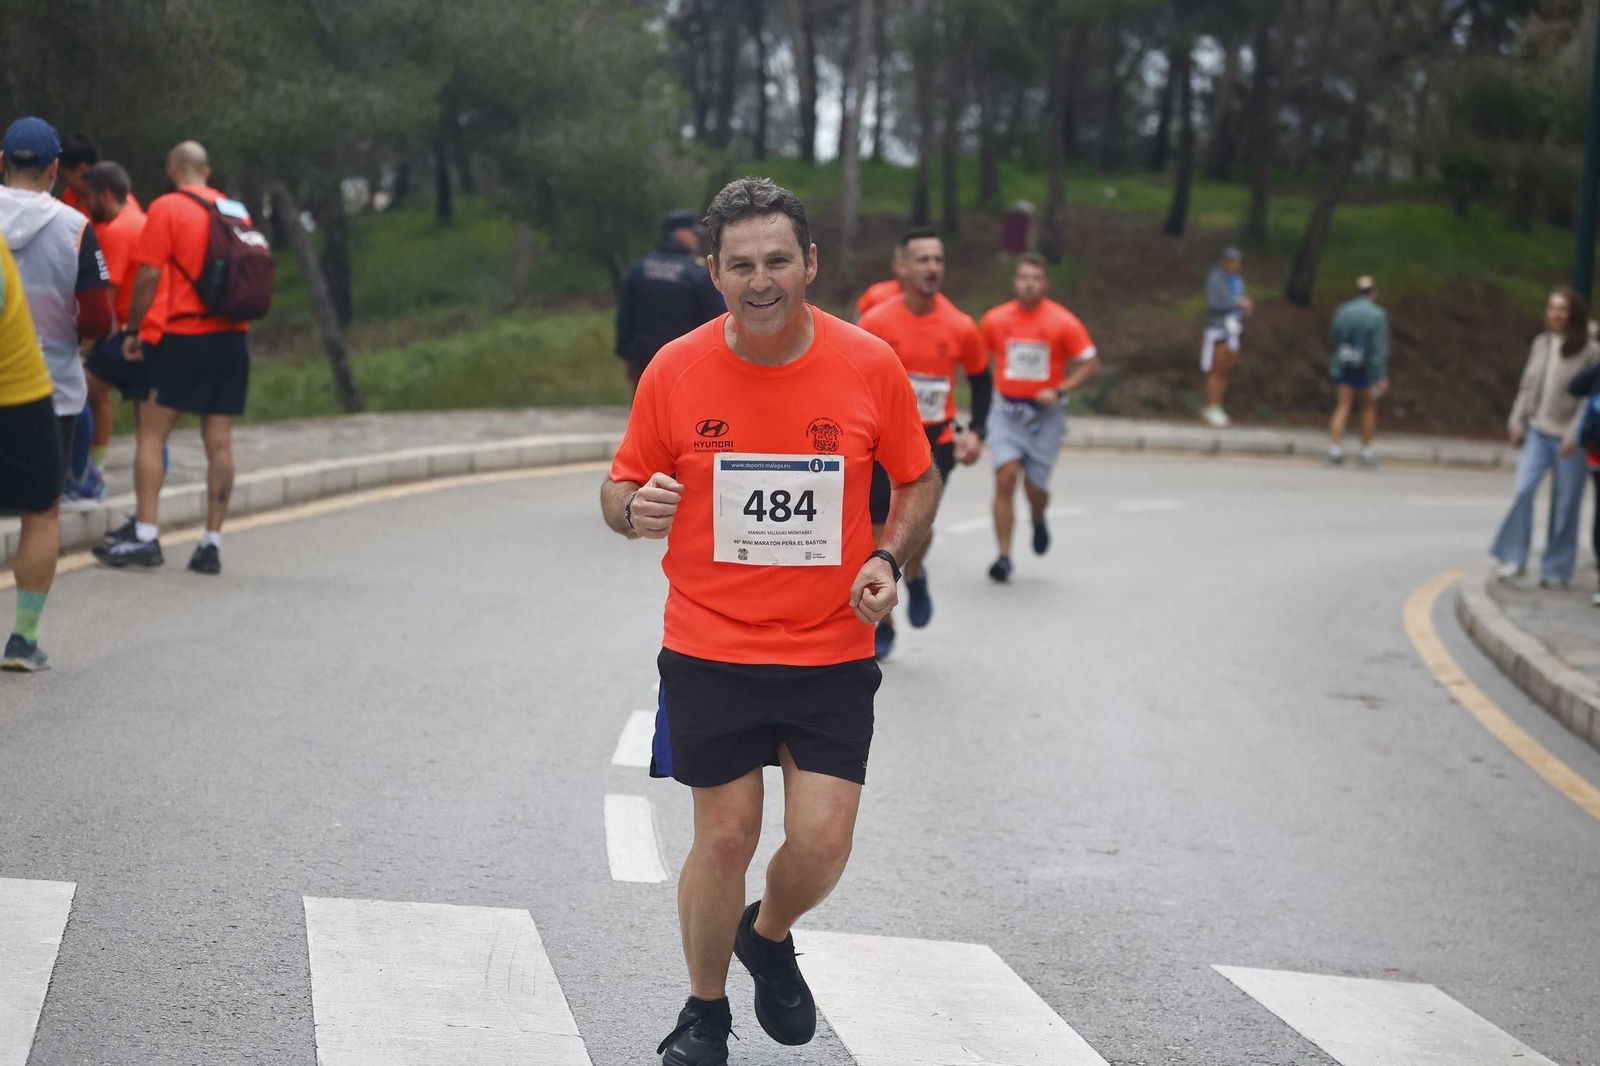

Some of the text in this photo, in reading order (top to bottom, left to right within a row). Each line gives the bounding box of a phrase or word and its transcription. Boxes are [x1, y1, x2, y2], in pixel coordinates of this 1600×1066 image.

[693, 440, 734, 448] HYUNDAI
[730, 462, 791, 470] www.deporte.malaga.eu
[743, 489, 818, 523] 484
